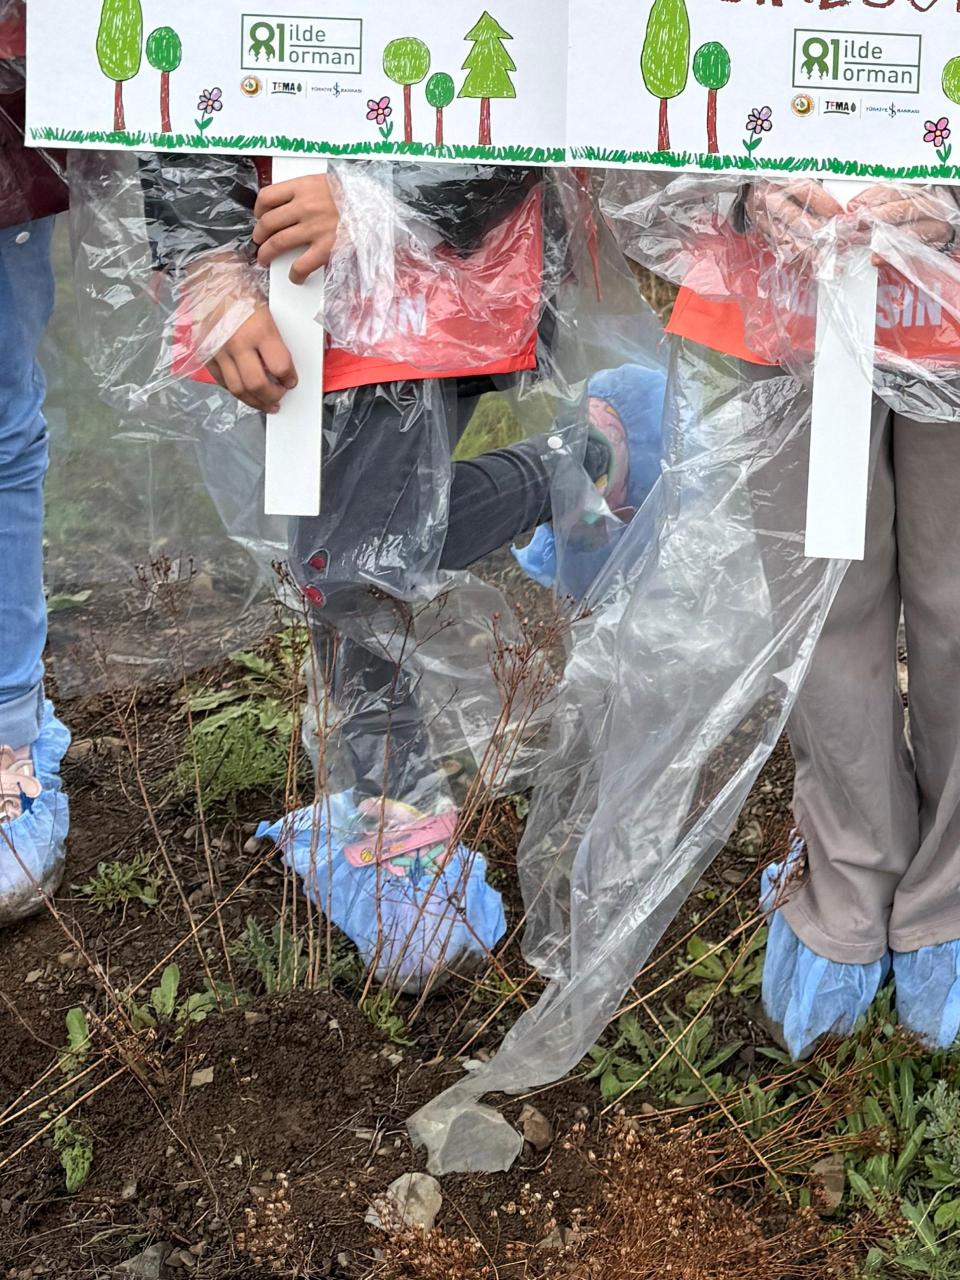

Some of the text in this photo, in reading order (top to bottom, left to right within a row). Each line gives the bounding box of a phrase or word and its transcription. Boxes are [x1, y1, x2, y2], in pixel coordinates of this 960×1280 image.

[289, 24, 326, 42] ilde
[289, 50, 355, 65] orman
[844, 40, 883, 59] ilde
[843, 67, 913, 84] orman
